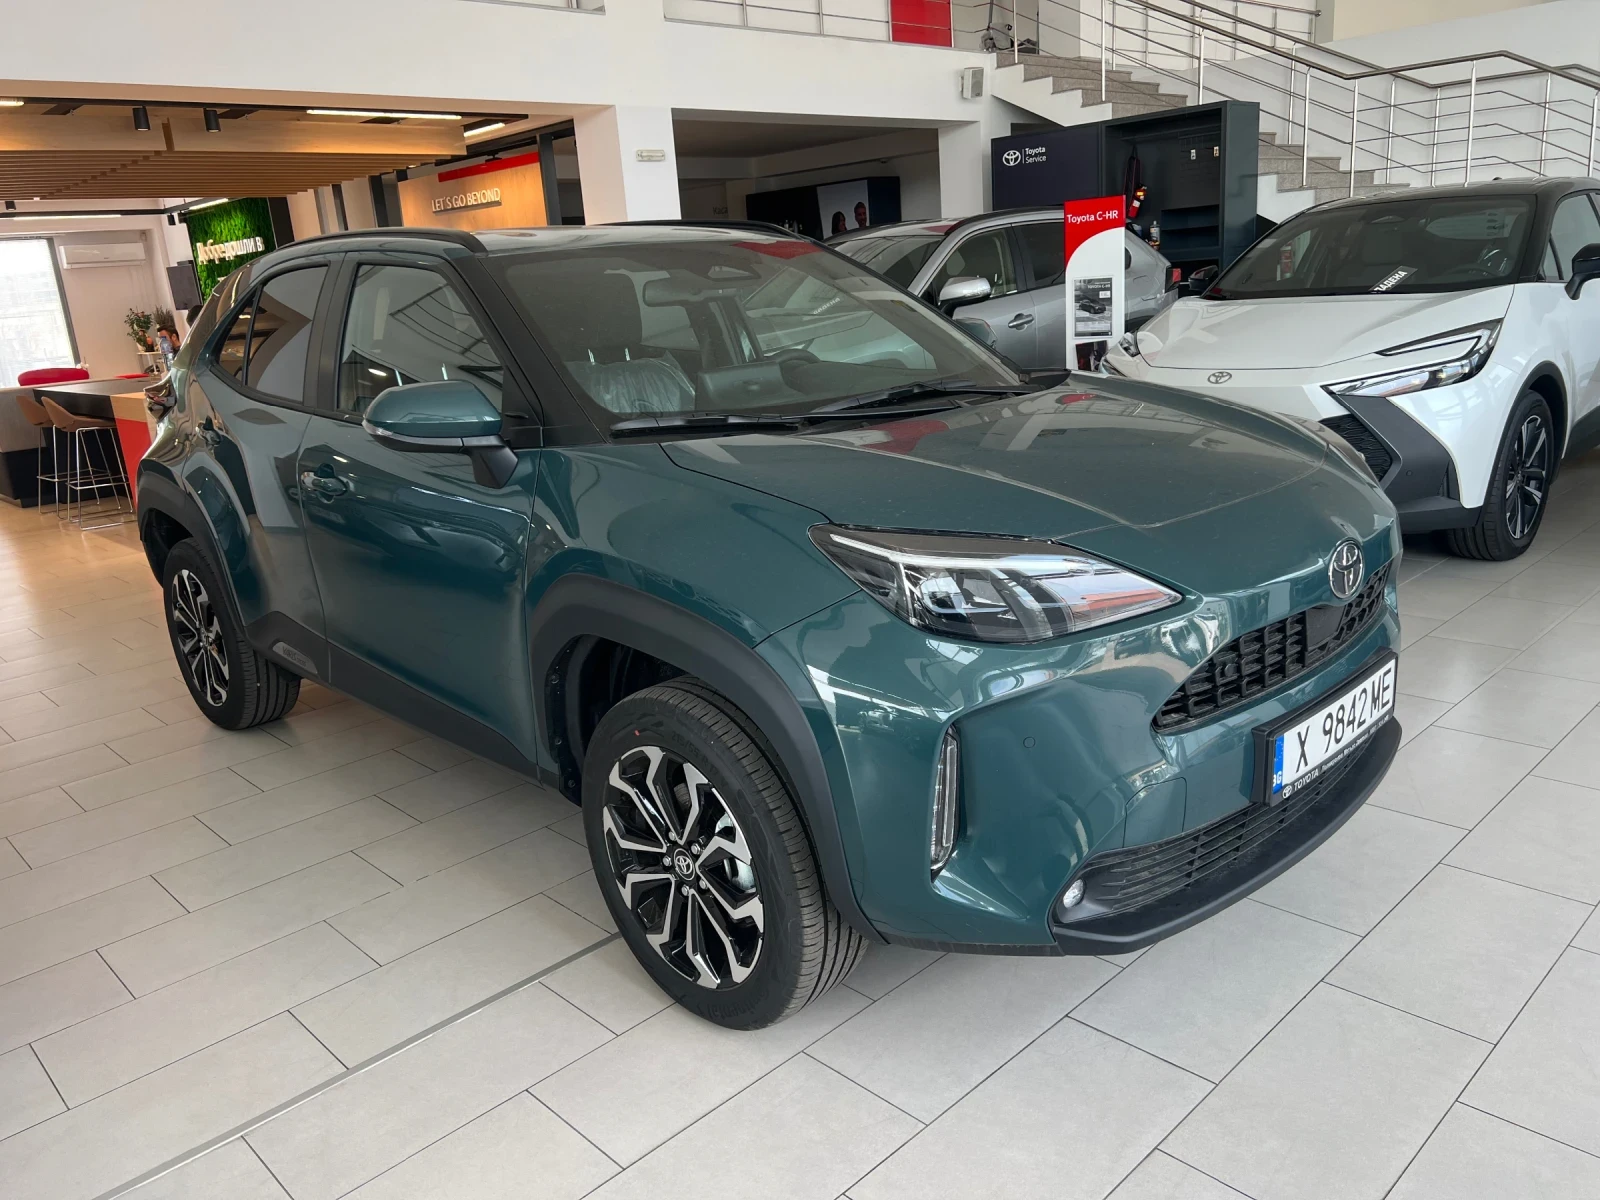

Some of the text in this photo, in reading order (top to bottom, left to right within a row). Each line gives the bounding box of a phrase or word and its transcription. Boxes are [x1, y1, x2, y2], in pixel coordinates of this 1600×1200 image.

[1025, 146, 1046, 156] Toyota
[1025, 155, 1047, 164] Service
[431, 187, 501, 212] LET'S GO BEYOND
[1066, 209, 1119, 225] Toyota C-HR
[255, 236, 265, 252] в
[1295, 724, 1311, 774] X
[1322, 687, 1368, 754] 9842
[1370, 667, 1392, 719] ME
[1293, 768, 1319, 791] TOYOTA
